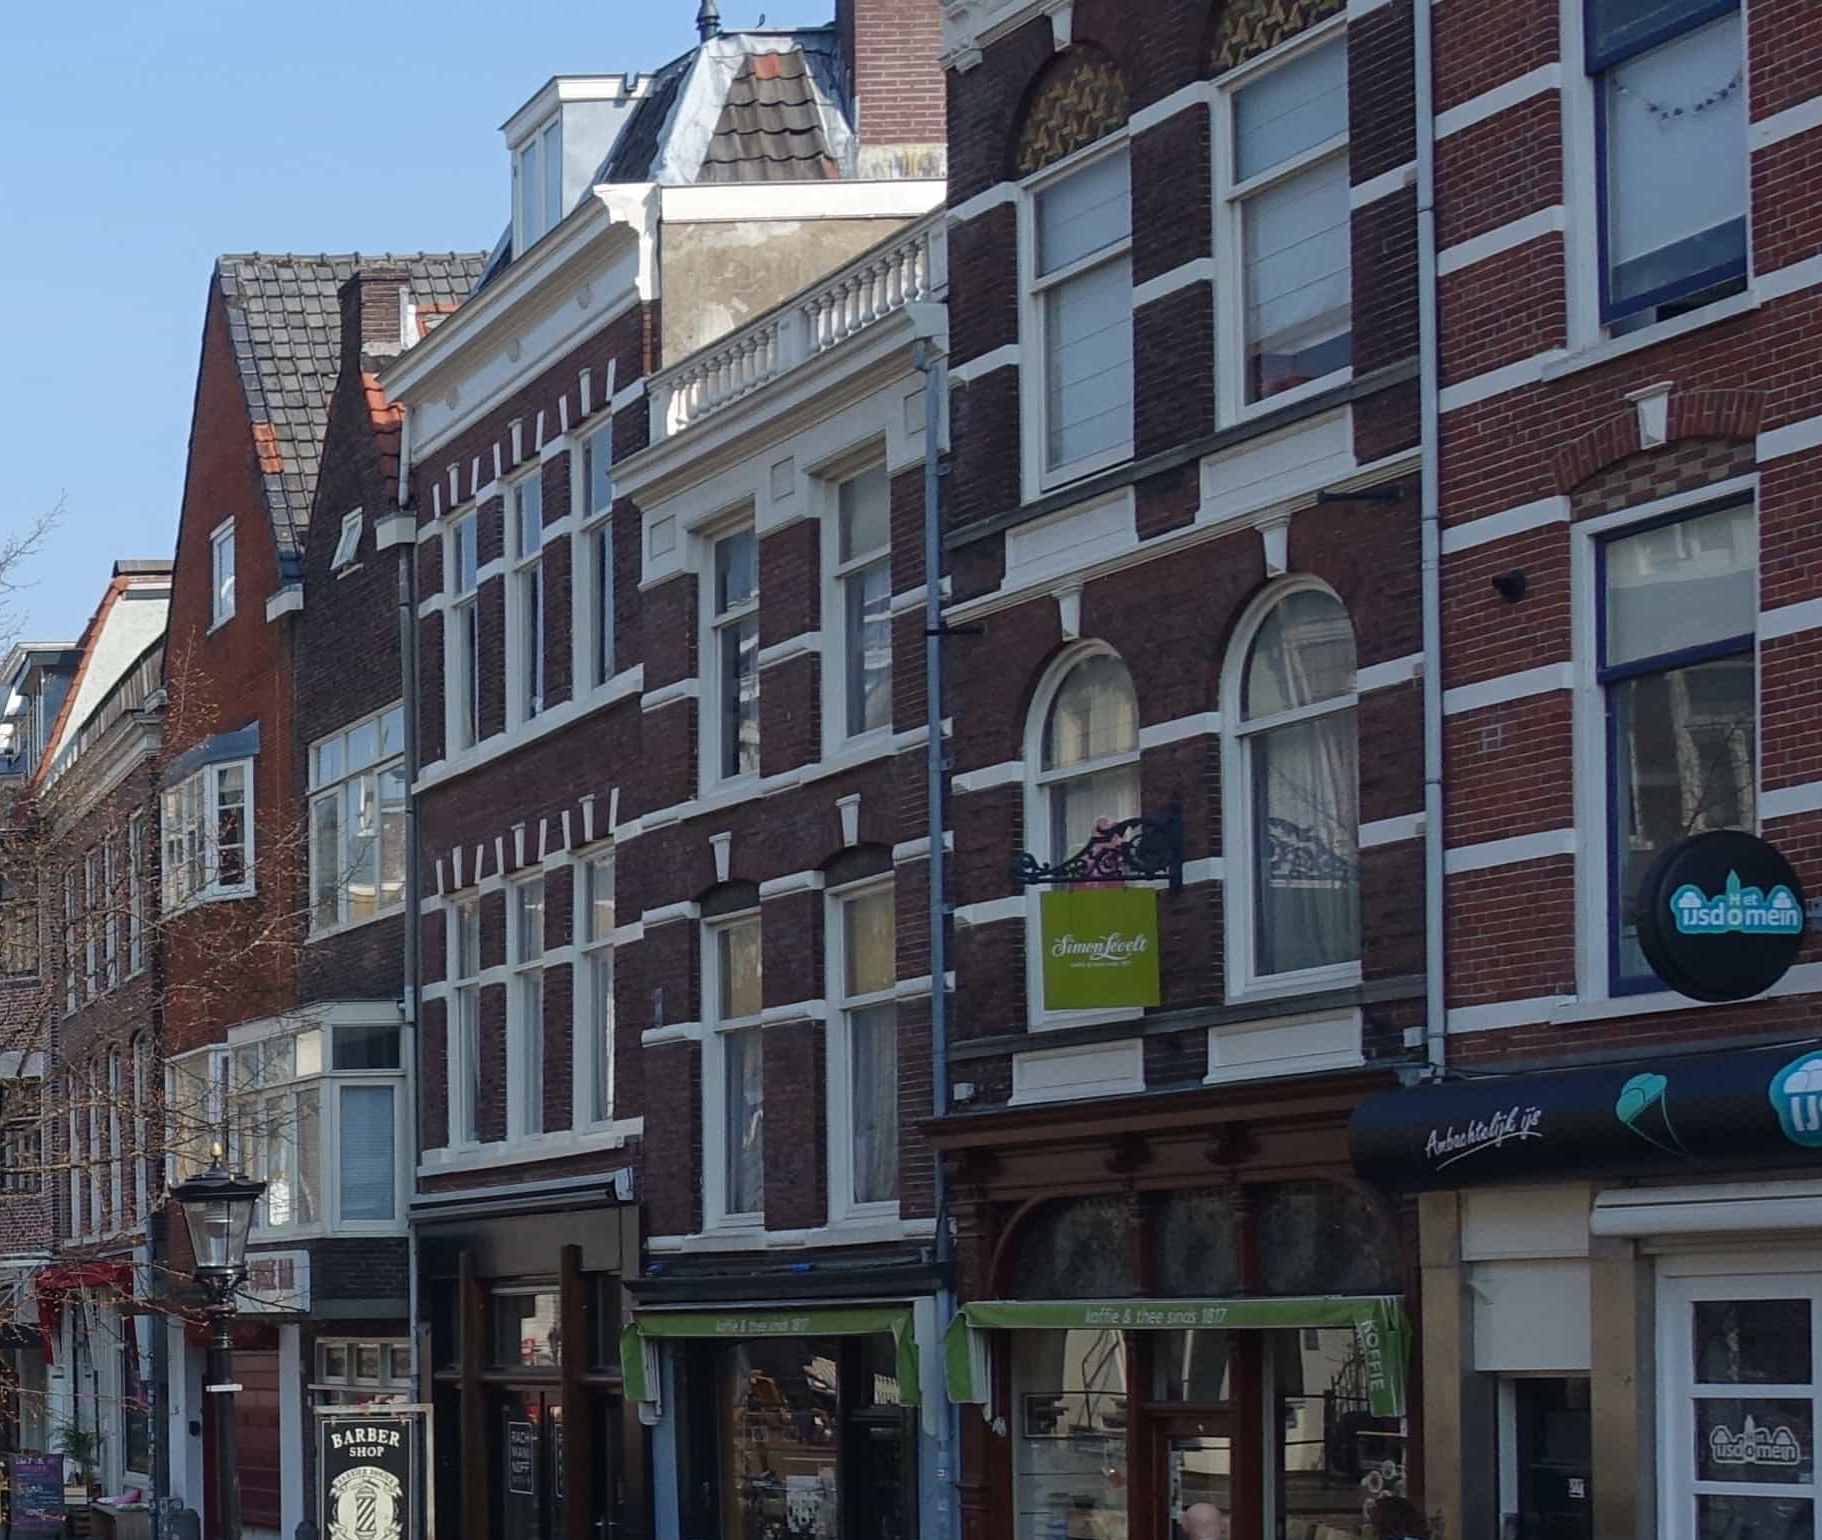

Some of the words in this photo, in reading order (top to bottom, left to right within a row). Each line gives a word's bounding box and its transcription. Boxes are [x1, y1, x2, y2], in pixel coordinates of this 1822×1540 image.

[1052, 933, 1102, 958] Simon
[331, 1427, 400, 1448] BARBER
[349, 1446, 385, 1457] SHOP
